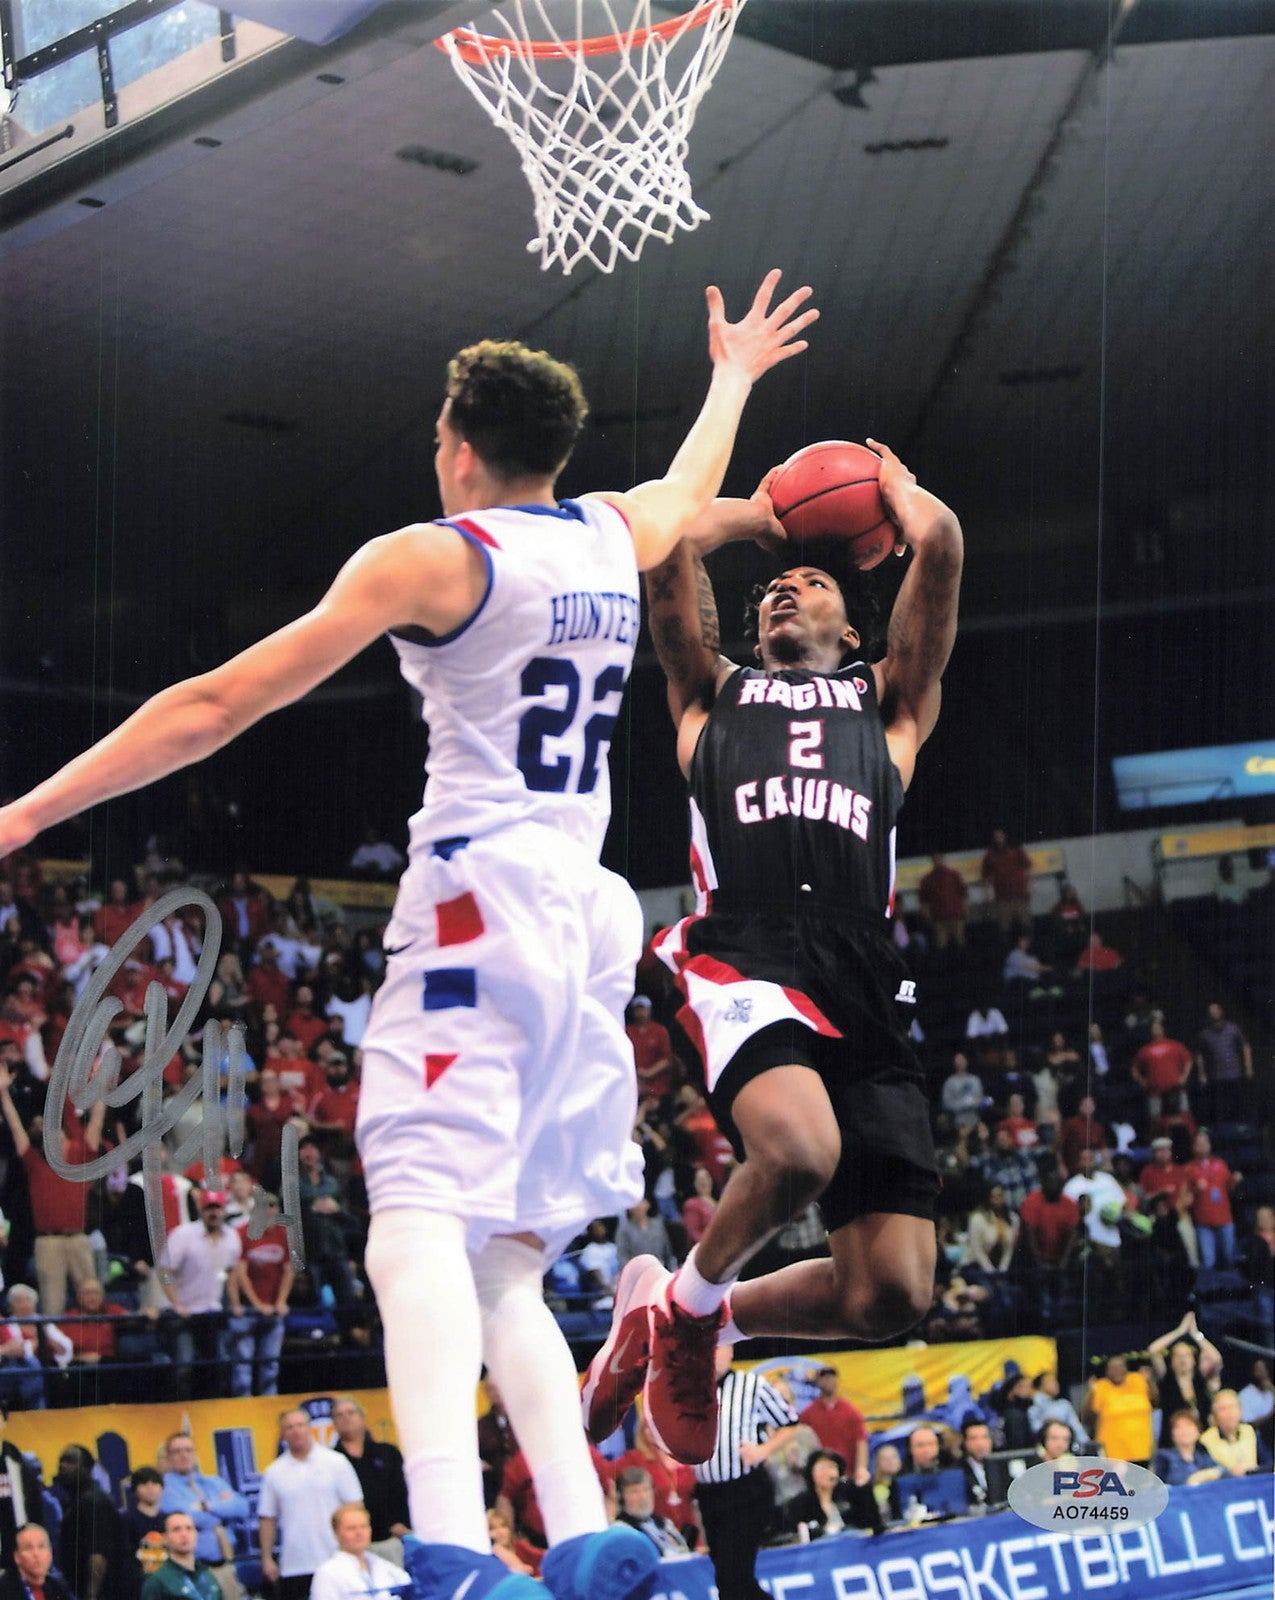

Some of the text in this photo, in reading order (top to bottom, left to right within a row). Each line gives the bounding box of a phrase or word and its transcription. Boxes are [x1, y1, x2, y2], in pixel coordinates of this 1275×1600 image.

[516, 656, 626, 794] 22
[787, 719, 825, 770] 2
[734, 774, 873, 842] CAJUNS
[831, 1511, 1225, 1600] BASKETBALL
